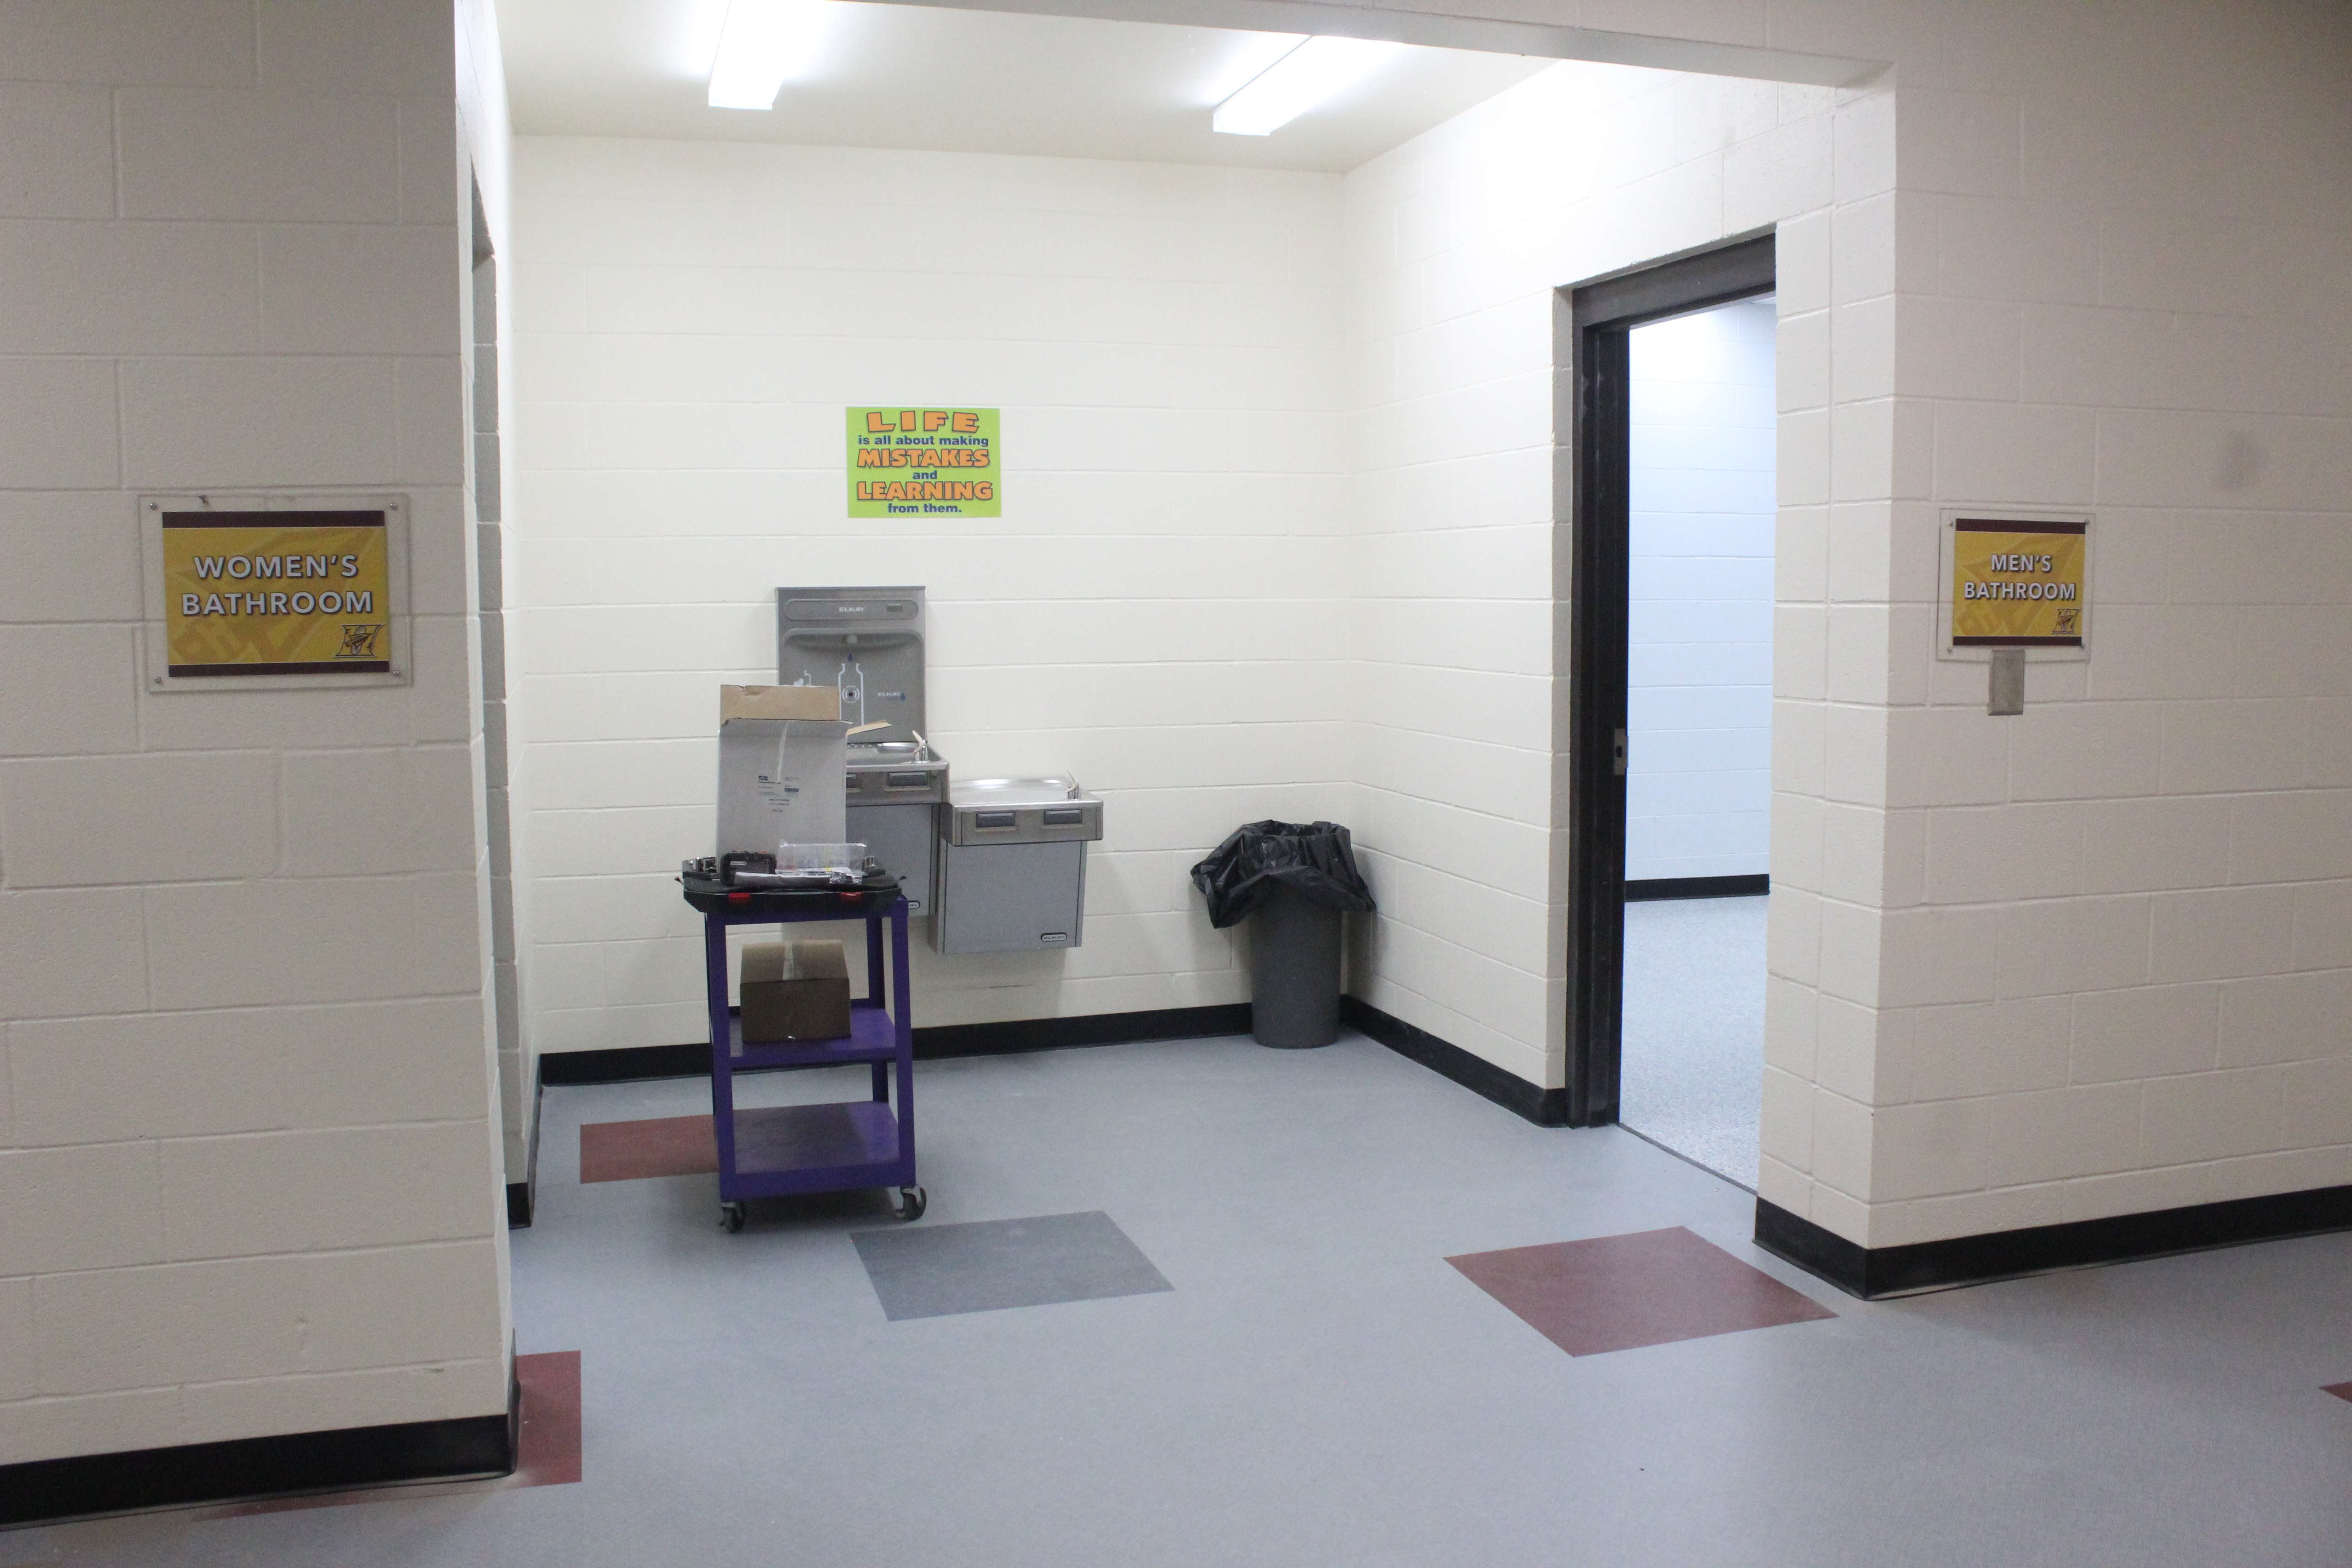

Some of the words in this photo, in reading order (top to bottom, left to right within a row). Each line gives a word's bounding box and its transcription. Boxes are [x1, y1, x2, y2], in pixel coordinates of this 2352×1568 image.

[867, 411, 980, 433] LIFE
[858, 435, 870, 445] is
[874, 436, 891, 445] all
[896, 436, 934, 445] about
[939, 436, 989, 447] making
[857, 448, 990, 468] MISTAKES
[912, 470, 937, 480] and
[857, 481, 993, 500] LEARNING
[887, 503, 919, 513] from
[923, 503, 962, 513] them.
[193, 554, 358, 579] WOMEN'S
[1990, 554, 2052, 572] MEN'S
[1964, 581, 2076, 600] BATHROOM
[181, 591, 373, 616] BATHROOM
